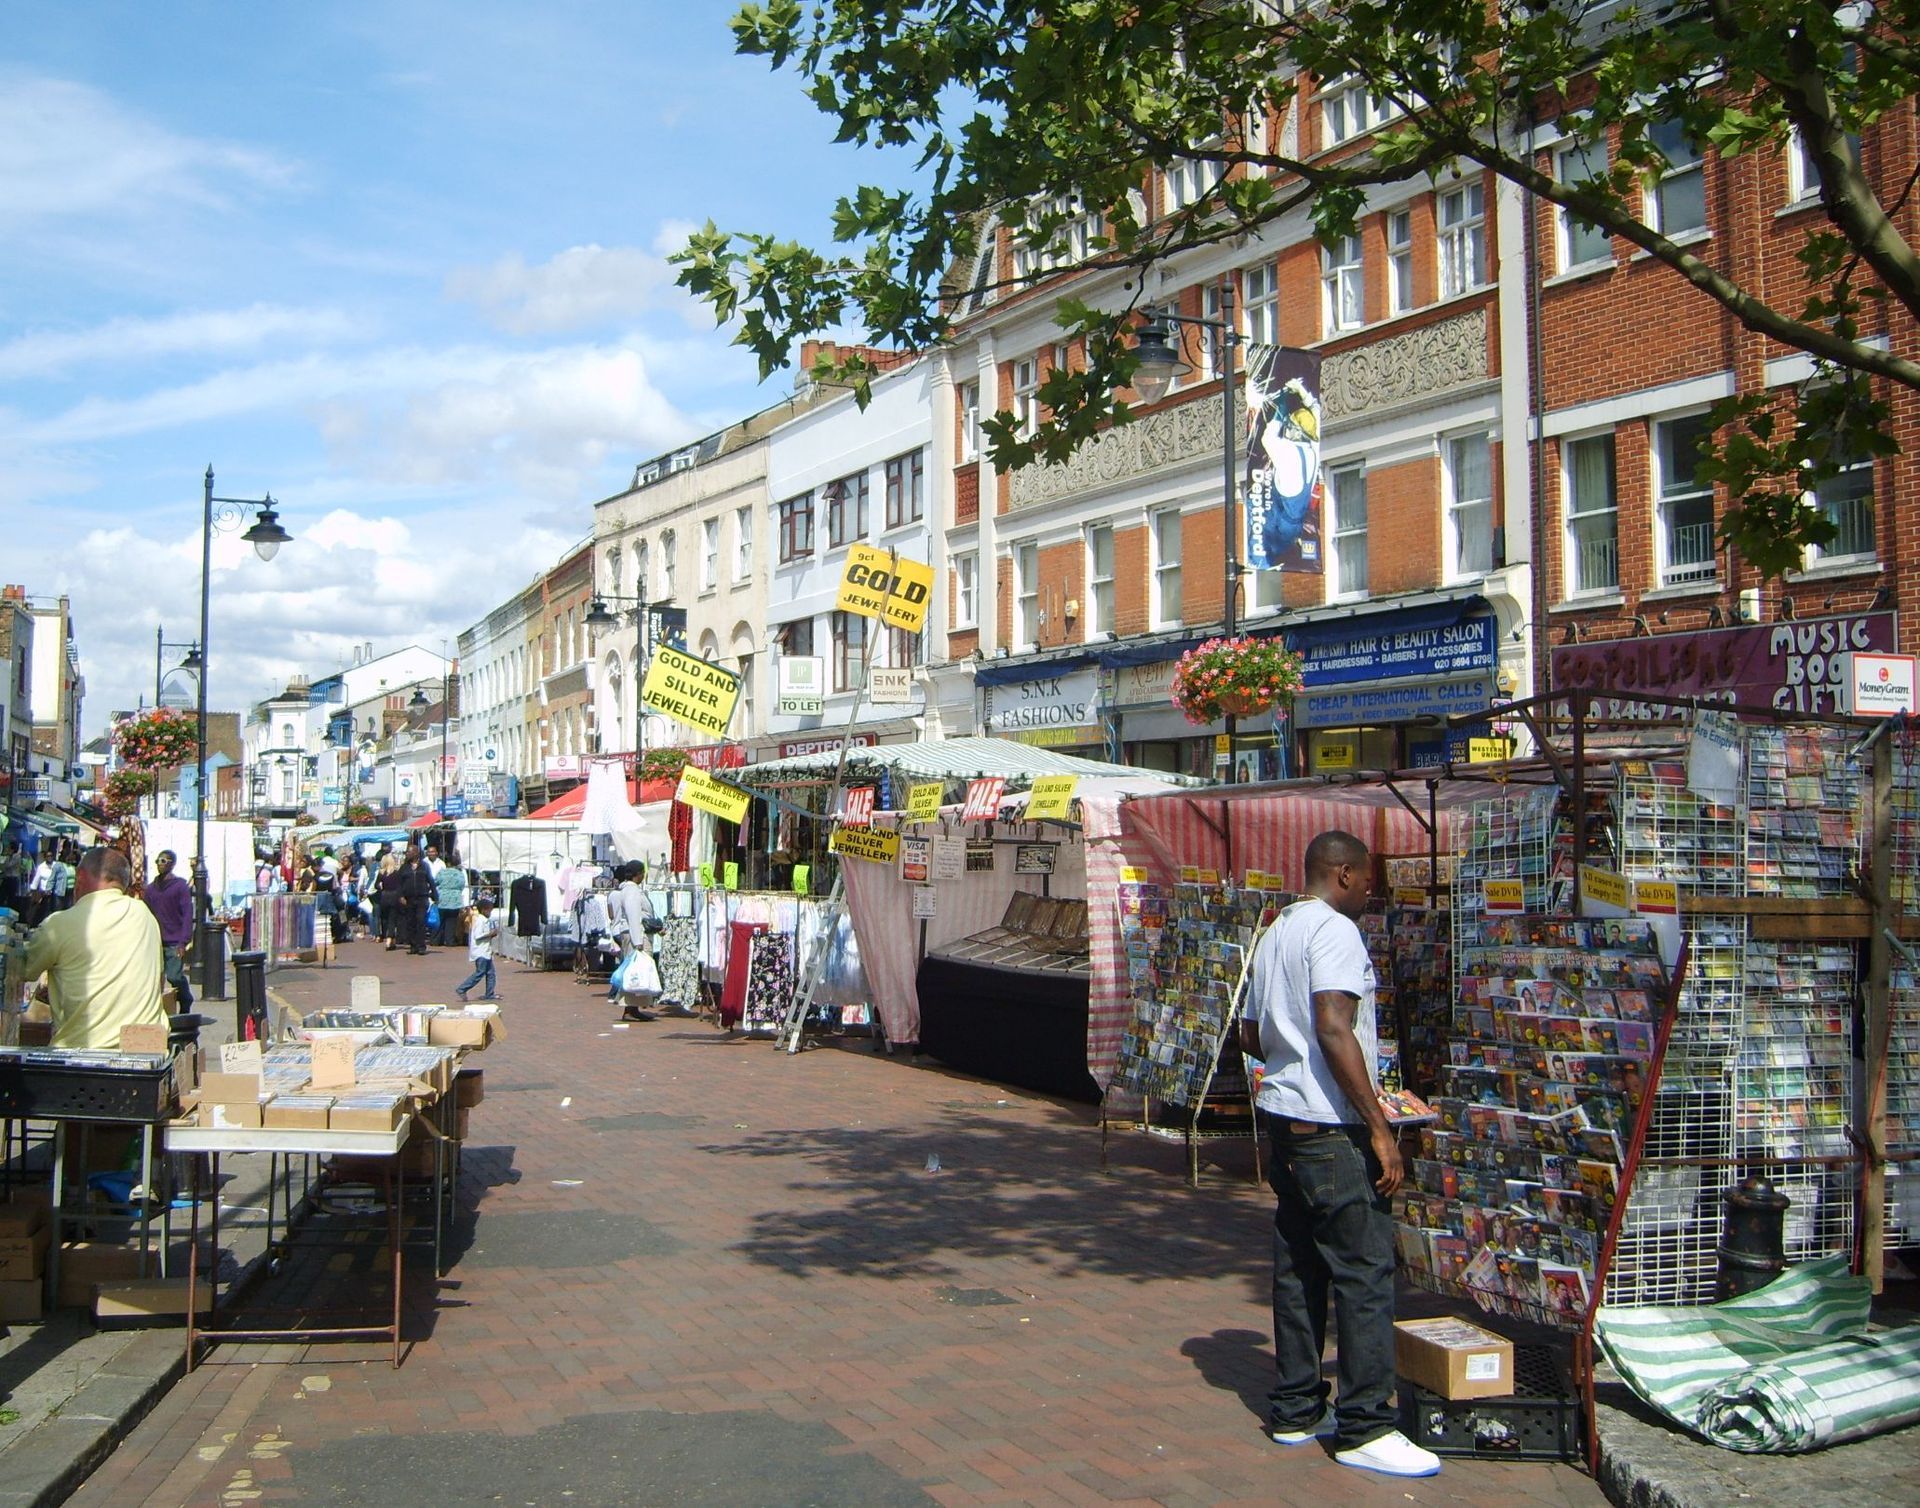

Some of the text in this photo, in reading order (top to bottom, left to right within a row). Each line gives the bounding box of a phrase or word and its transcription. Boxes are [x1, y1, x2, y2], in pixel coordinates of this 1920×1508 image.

[1251, 469, 1266, 556] Deptford
[846, 563, 927, 605] GOLD
[843, 593, 919, 623] JEWELERY
[1350, 637, 1377, 655] HAIR
[1394, 629, 1439, 650] BEAUTY
[1443, 622, 1485, 644] SALON
[1770, 619, 1871, 656] MUSIC
[1381, 649, 1417, 664] BARBERS
[1426, 641, 1483, 659] ACCESSORIES
[659, 651, 736, 694] GOLD AND
[873, 675, 906, 686] SNK
[1786, 652, 1843, 686] BOO
[664, 675, 719, 709] SILVER
[1021, 677, 1062, 700] S.N.K
[1308, 682, 1484, 711] CHEAP INTERNATIONAL CALLS
[1772, 683, 1845, 714] GIFT
[1859, 682, 1909, 695] MoneyGram
[642, 689, 727, 733] JEWELLERY
[782, 702, 821, 711] TO LET
[1003, 703, 1085, 727] FASHIONS
[1709, 729, 1733, 751] Empty
[685, 774, 746, 803] GOLD AND SILVER
[912, 786, 939, 798] GOLD AND
[964, 780, 1002, 817] SALE
[1054, 783, 1072, 792] SILVER
[691, 791, 732, 811] JEWELLERY
[844, 790, 873, 824] SALE
[914, 800, 932, 809] SILVER
[1033, 800, 1060, 809] JEWELLERY
[831, 843, 893, 862] JEWELLERY
[846, 834, 883, 849] SILVER
[907, 842, 926, 850] VISA
[1486, 887, 1522, 897] Sale DVDs
